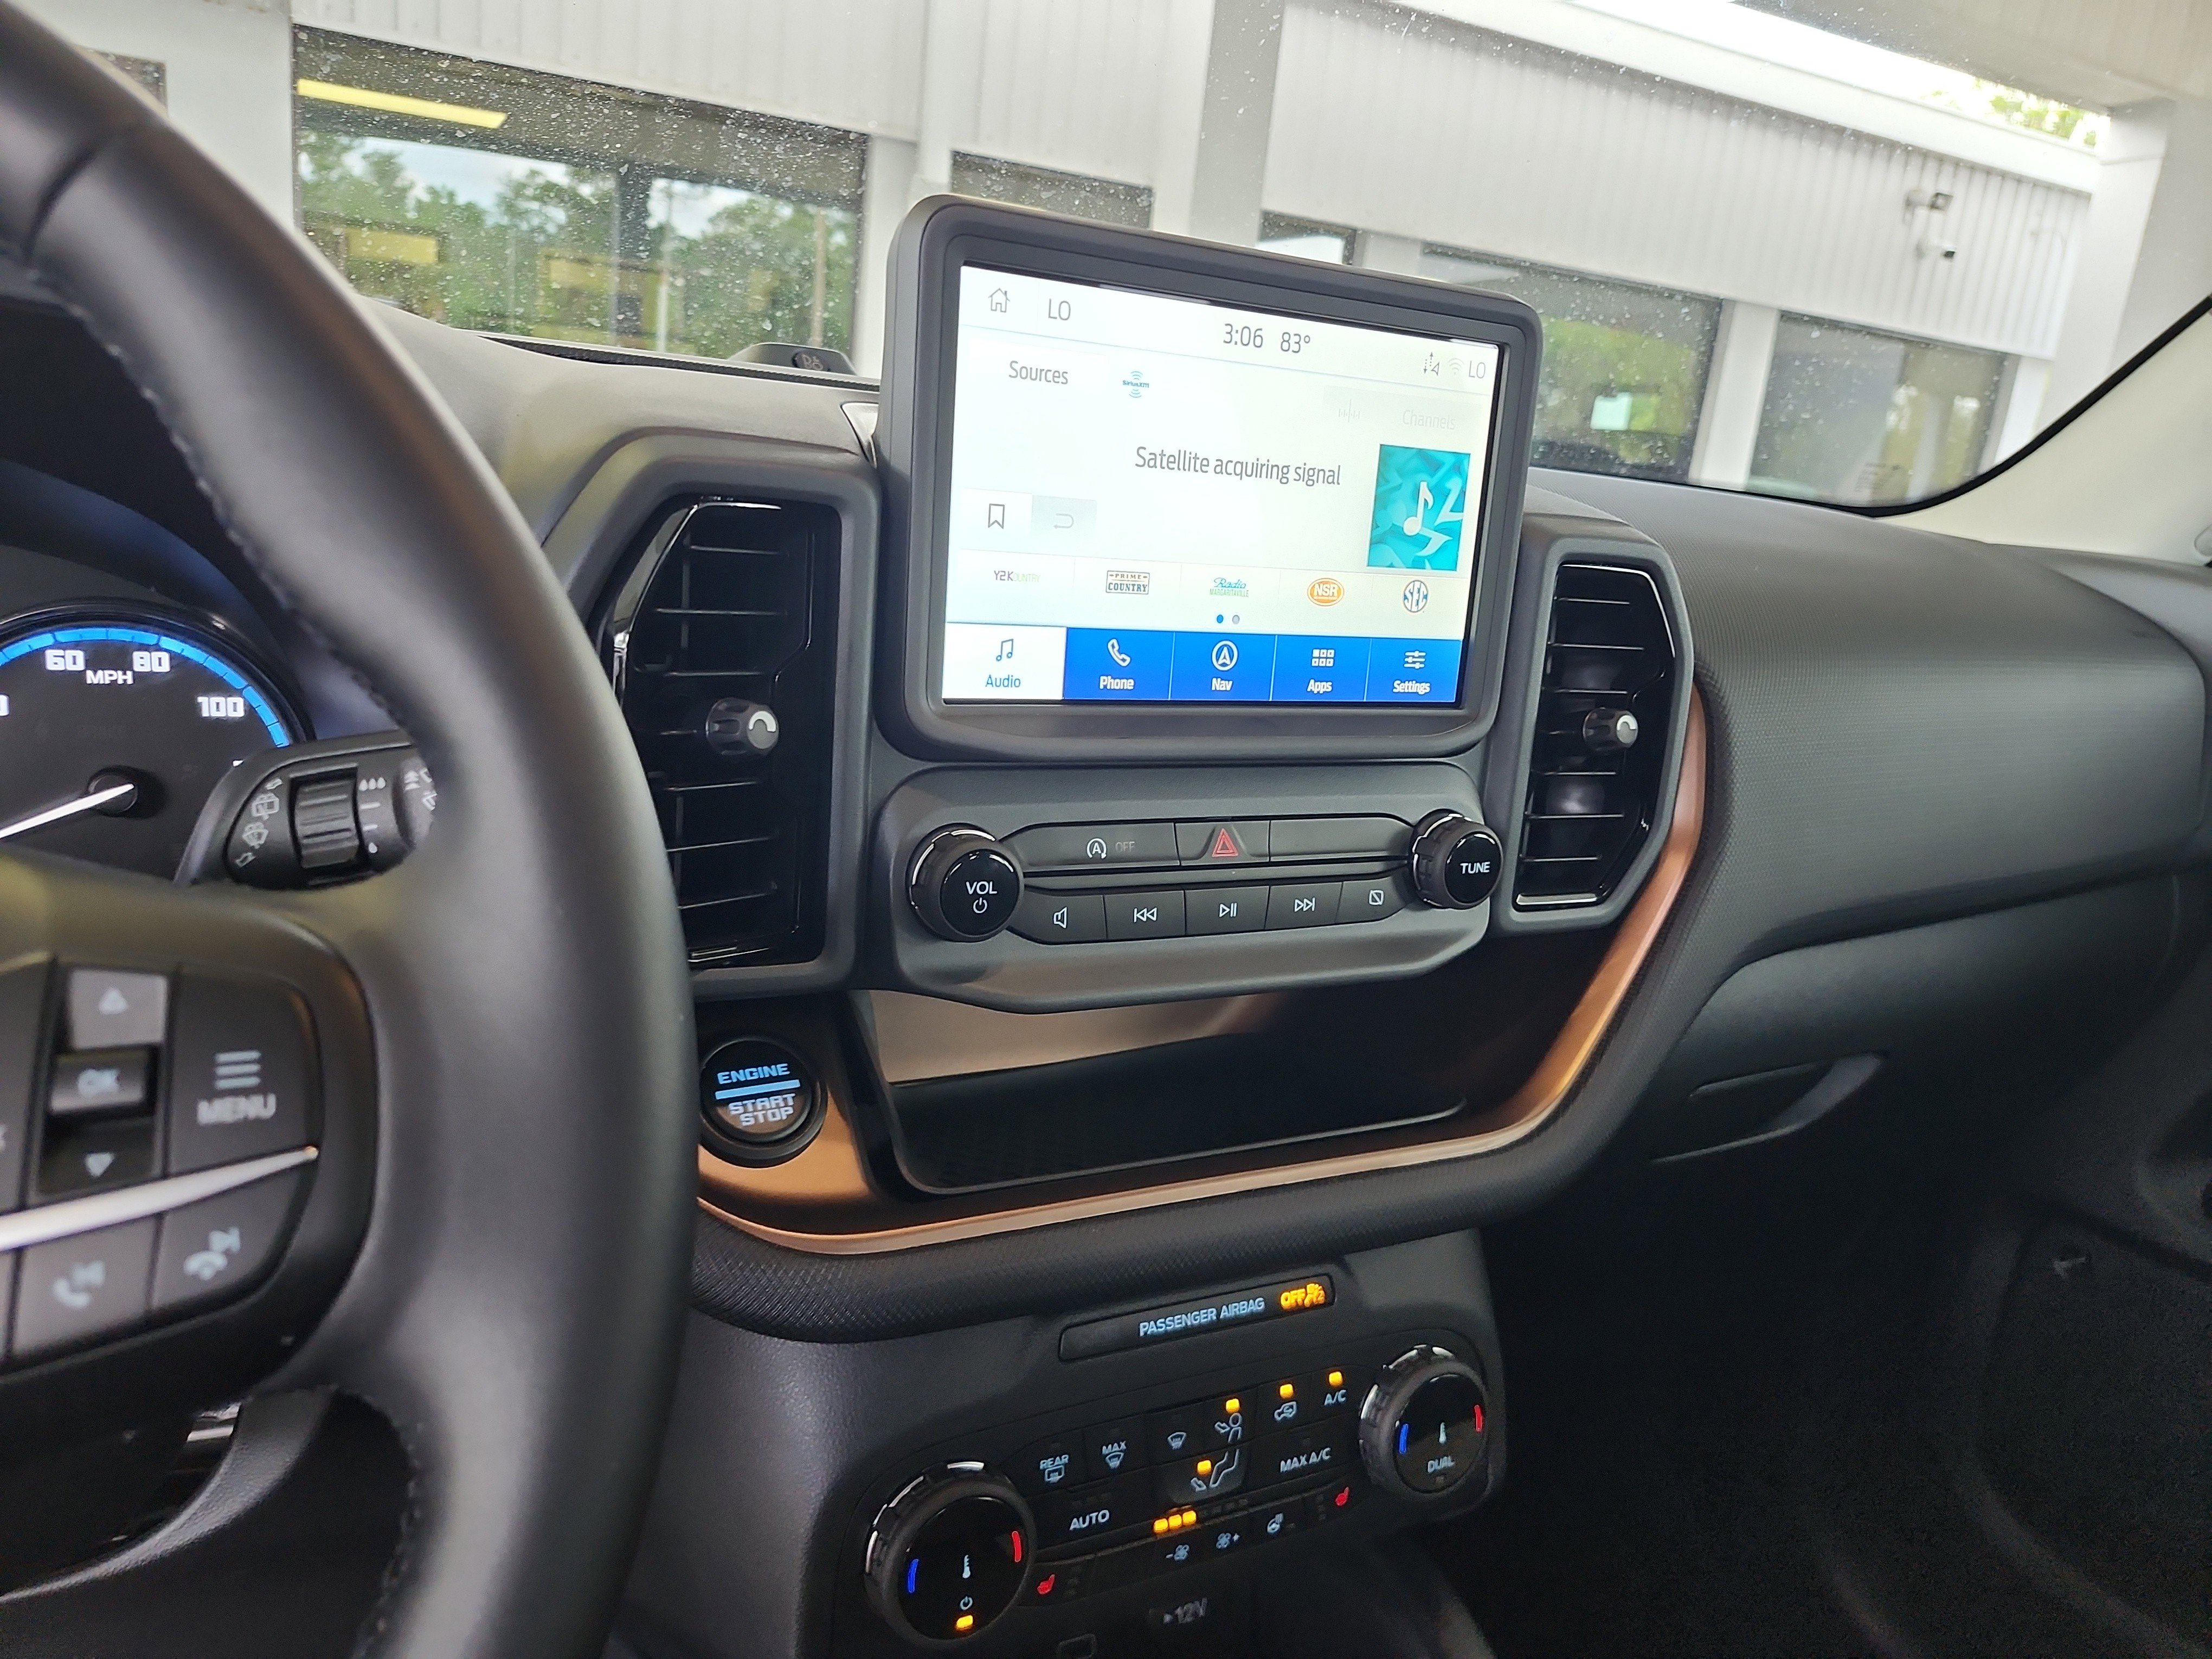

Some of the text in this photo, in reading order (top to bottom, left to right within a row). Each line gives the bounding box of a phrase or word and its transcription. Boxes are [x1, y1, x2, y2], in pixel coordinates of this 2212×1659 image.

[1047, 298, 1071, 321] LO
[1223, 323, 1311, 353] 3:06 83°
[1009, 361, 1069, 385] Sources
[1468, 361, 1486, 380] LO
[1403, 408, 1456, 430] Channels
[1135, 446, 1341, 486] Satellite acquiring signal
[1108, 582, 1148, 593] COUNTRY
[1213, 577, 1247, 589] Radio
[1404, 580, 1429, 613] SEC
[44, 650, 85, 671] 60
[132, 651, 171, 673] 80
[86, 670, 134, 684] MPH
[985, 674, 1021, 689] Audio
[1099, 676, 1135, 691] Phone
[1211, 677, 1233, 691] Nav
[1307, 679, 1333, 694] Apps
[1393, 680, 1431, 695] Settings
[197, 696, 245, 717] 100
[1115, 841, 1135, 853] OFF
[1460, 861, 1490, 874] TUNE
[966, 880, 998, 895] VOL
[717, 1063, 790, 1084] ENGINE
[197, 1093, 276, 1126] MENU
[728, 1093, 796, 1115] START
[739, 1106, 794, 1127] STOP
[1139, 1288, 1306, 1336] PASSENGER AIRBAG OFF
[1324, 1389, 1347, 1406] A/C
[1102, 1441, 1127, 1455] MAX
[1039, 1454, 1069, 1470] REAR
[1279, 1446, 1332, 1474] MAX A/C
[1427, 1455, 1456, 1474] DUAL
[1069, 1509, 1110, 1531] AUTO
[1174, 1597, 1208, 1624] 12V
